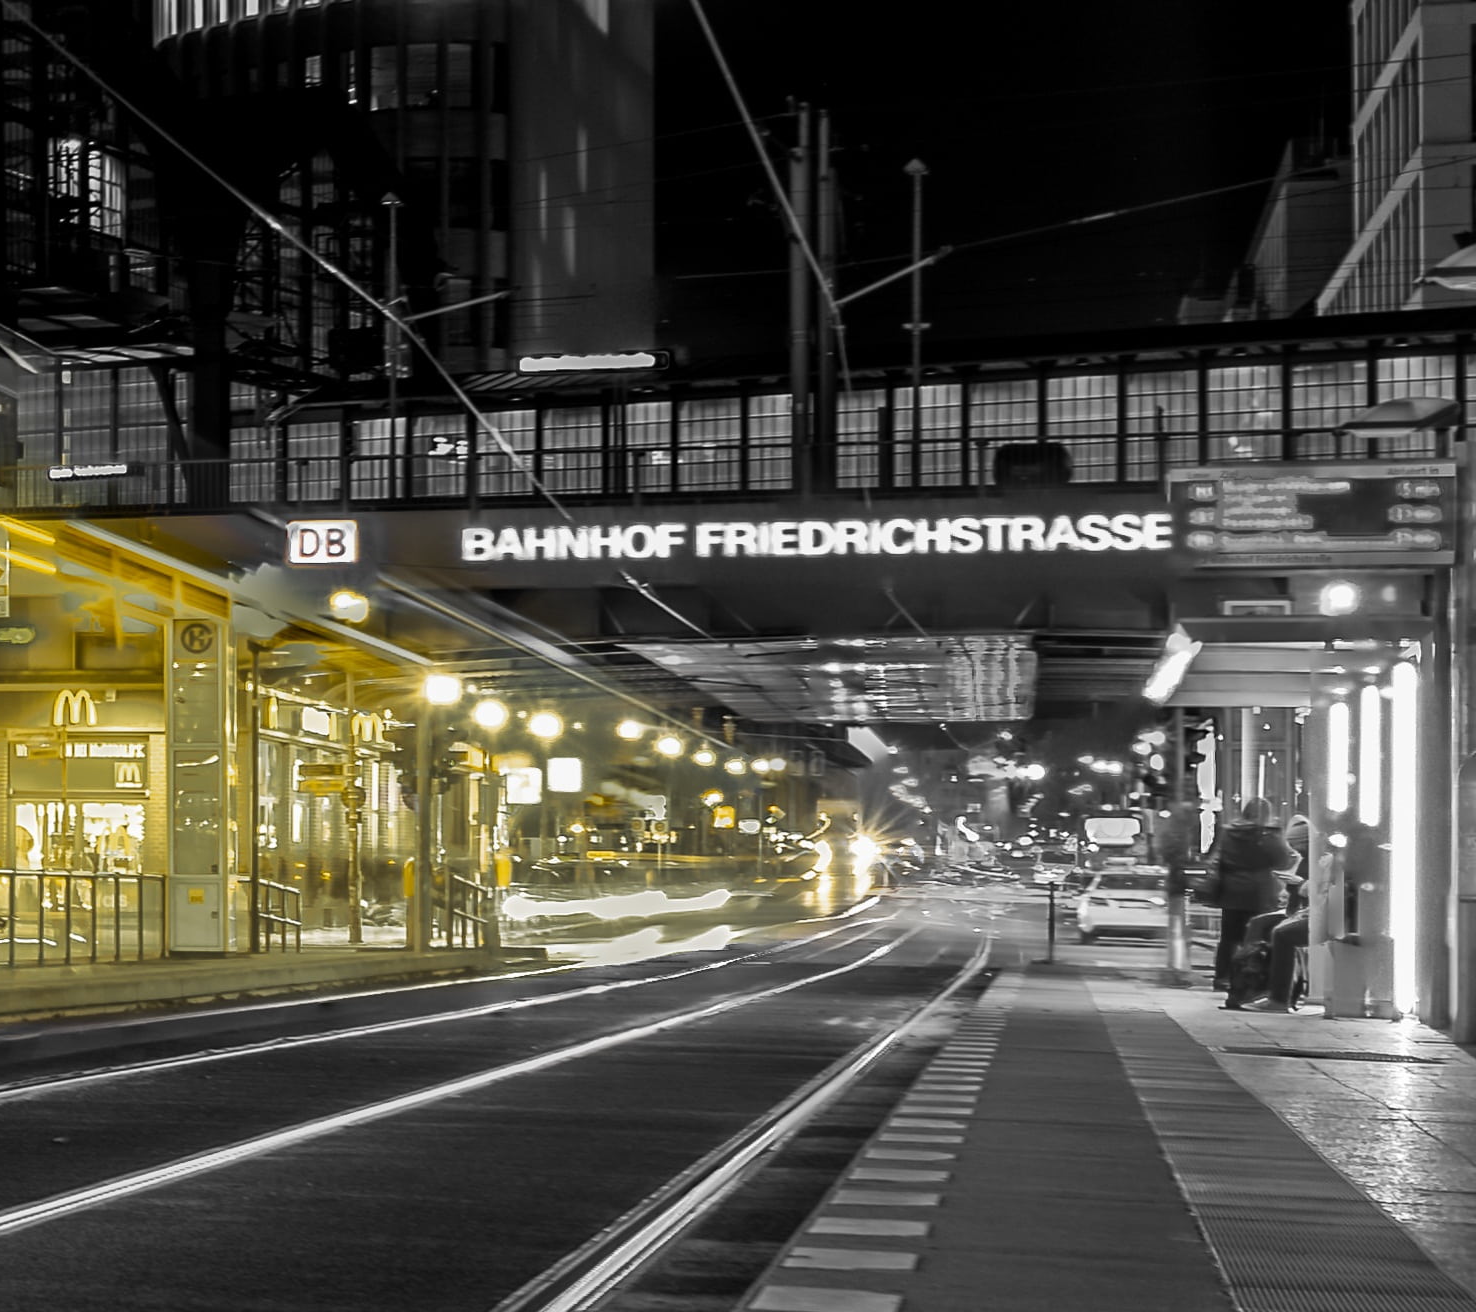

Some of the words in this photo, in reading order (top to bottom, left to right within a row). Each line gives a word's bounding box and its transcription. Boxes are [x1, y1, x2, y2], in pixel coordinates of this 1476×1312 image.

[298, 528, 347, 558] DB
[462, 523, 687, 562] BAHNHOF
[695, 513, 1172, 557] FRIEDRICHSTRASSE
